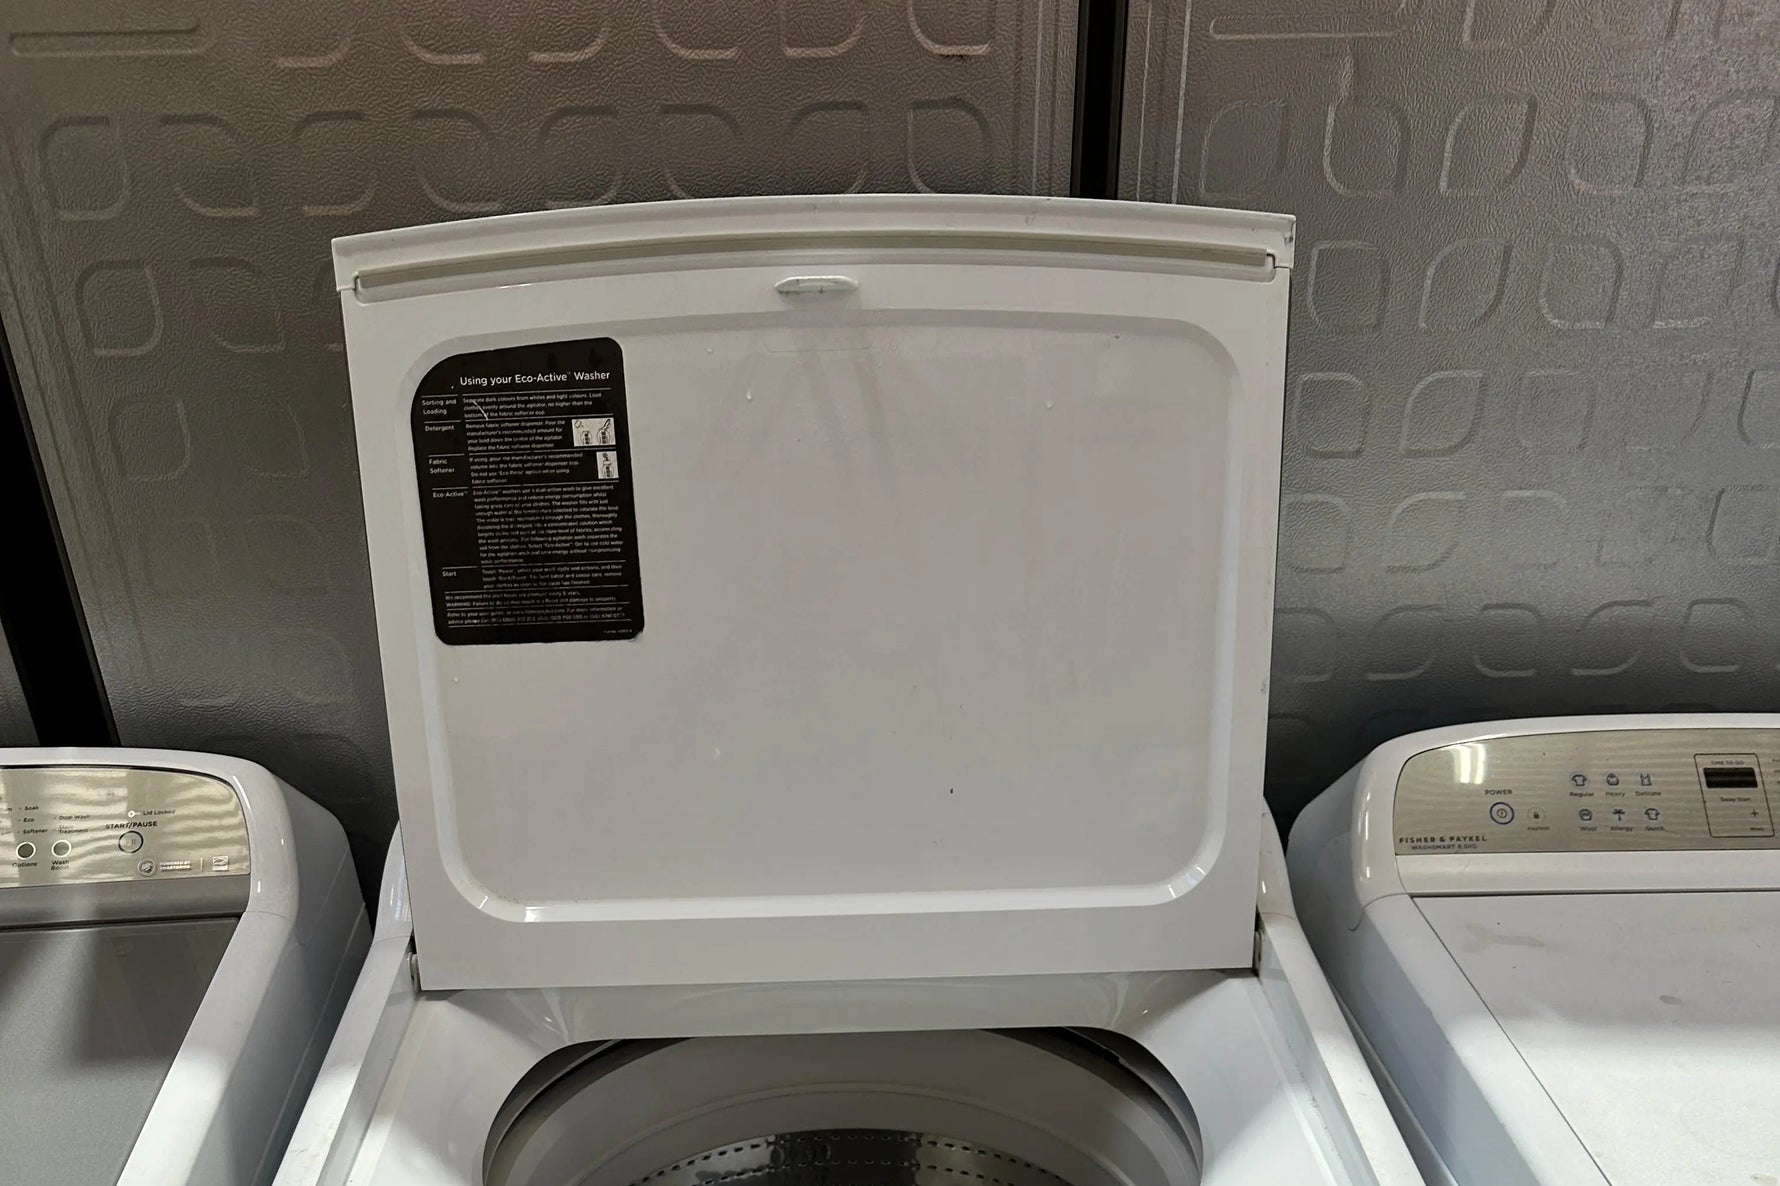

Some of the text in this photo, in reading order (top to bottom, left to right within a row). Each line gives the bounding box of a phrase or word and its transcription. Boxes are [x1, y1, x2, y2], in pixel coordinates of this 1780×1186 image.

[460, 376, 488, 386] Using
[490, 376, 512, 386] your
[574, 371, 610, 381] Washer
[422, 408, 447, 416] Loading
[106, 821, 158, 829] START/PAUSE
